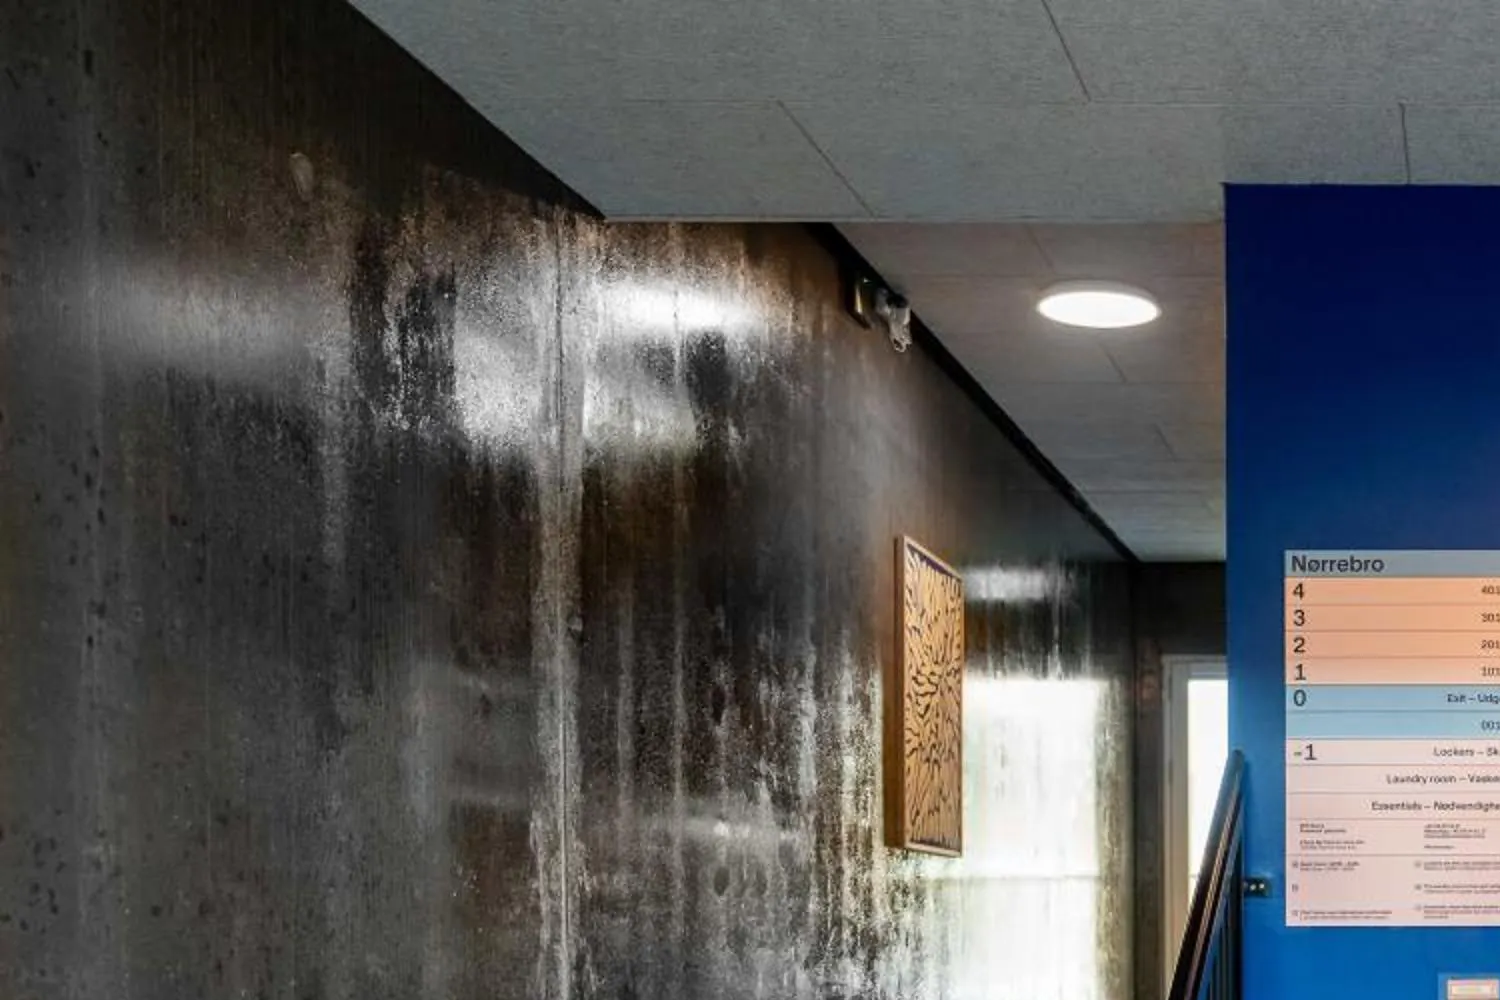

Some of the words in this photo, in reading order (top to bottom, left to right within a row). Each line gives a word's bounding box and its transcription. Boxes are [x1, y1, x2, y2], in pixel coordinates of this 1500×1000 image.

[1292, 555, 1384, 573] Nørrebro
[1292, 582, 1305, 600] 4
[1293, 609, 1305, 627] 3
[1293, 636, 1306, 653] 2
[1295, 663, 1306, 681] 1
[1293, 689, 1307, 707] 0
[1447, 693, 1466, 703] Exit
[1433, 746, 1475, 757] Lockers
[1386, 774, 1428, 786] Laundry
[1429, 775, 1457, 784] room
[1371, 801, 1422, 812] Essentials
